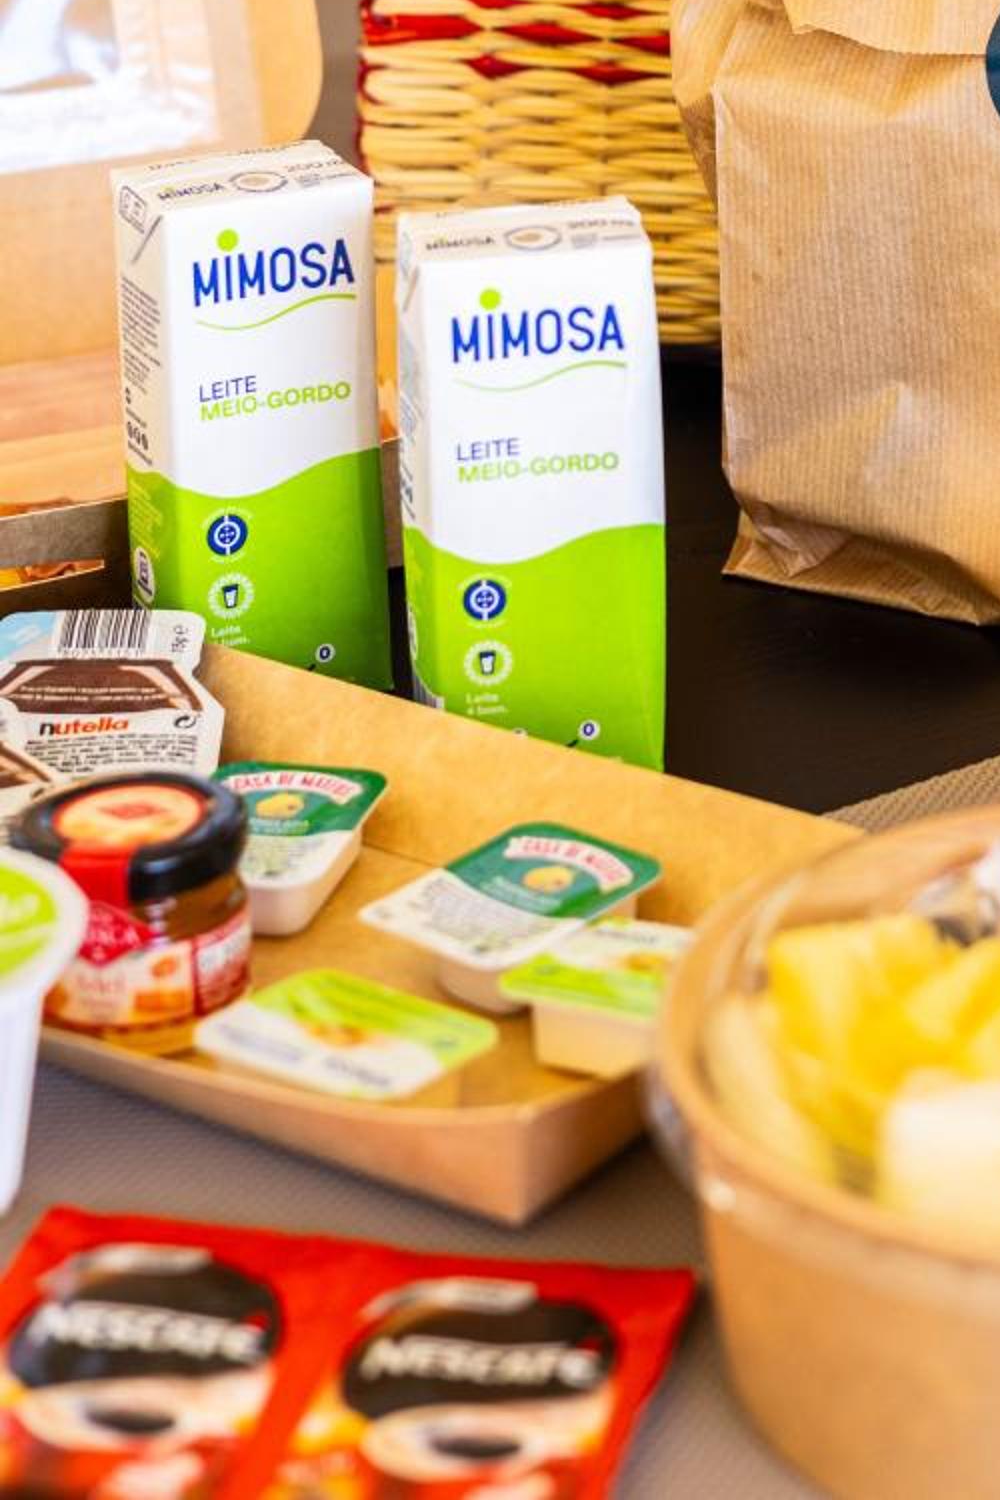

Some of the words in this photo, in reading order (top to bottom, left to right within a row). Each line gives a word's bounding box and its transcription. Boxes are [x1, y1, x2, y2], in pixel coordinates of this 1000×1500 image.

[192, 228, 356, 308] MIMOSA
[451, 288, 625, 364] MIMOSA
[199, 375, 257, 403] LEITE
[200, 380, 353, 422] MEIO-GORDO
[456, 437, 520, 462] LEITE
[457, 451, 620, 484] MEIO-GORDO
[39, 716, 130, 736] nutella
